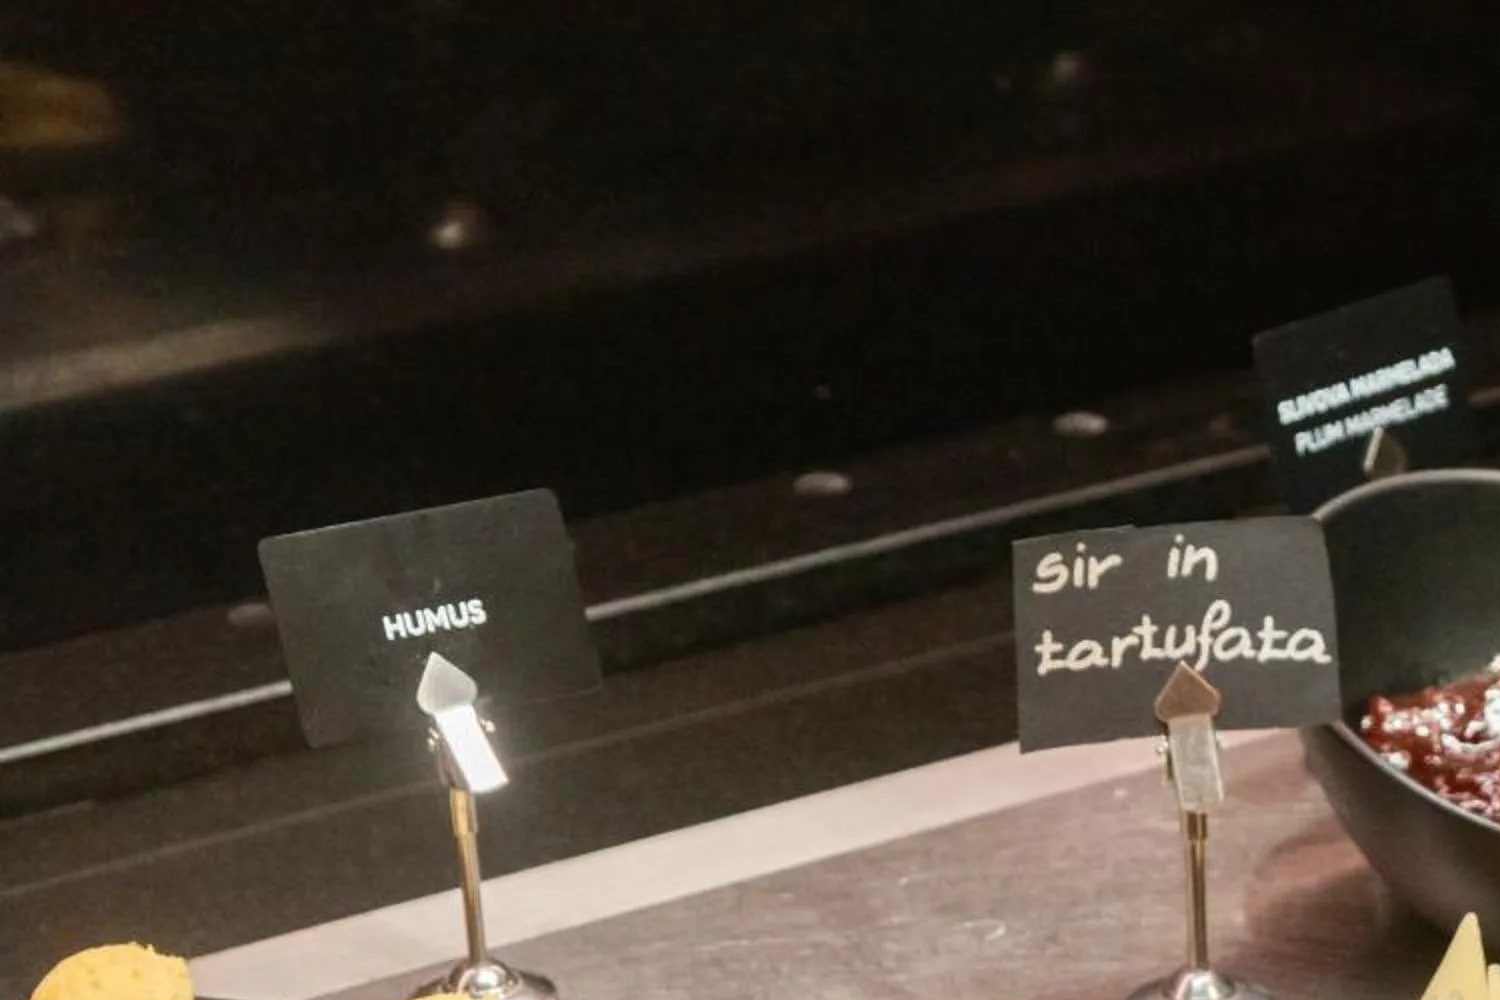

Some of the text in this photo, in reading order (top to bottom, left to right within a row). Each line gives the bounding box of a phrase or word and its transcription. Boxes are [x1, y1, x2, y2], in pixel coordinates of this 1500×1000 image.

[1033, 534, 1218, 593] sir in
[383, 599, 486, 640] HUMUS
[1035, 600, 1331, 676] tartufata
